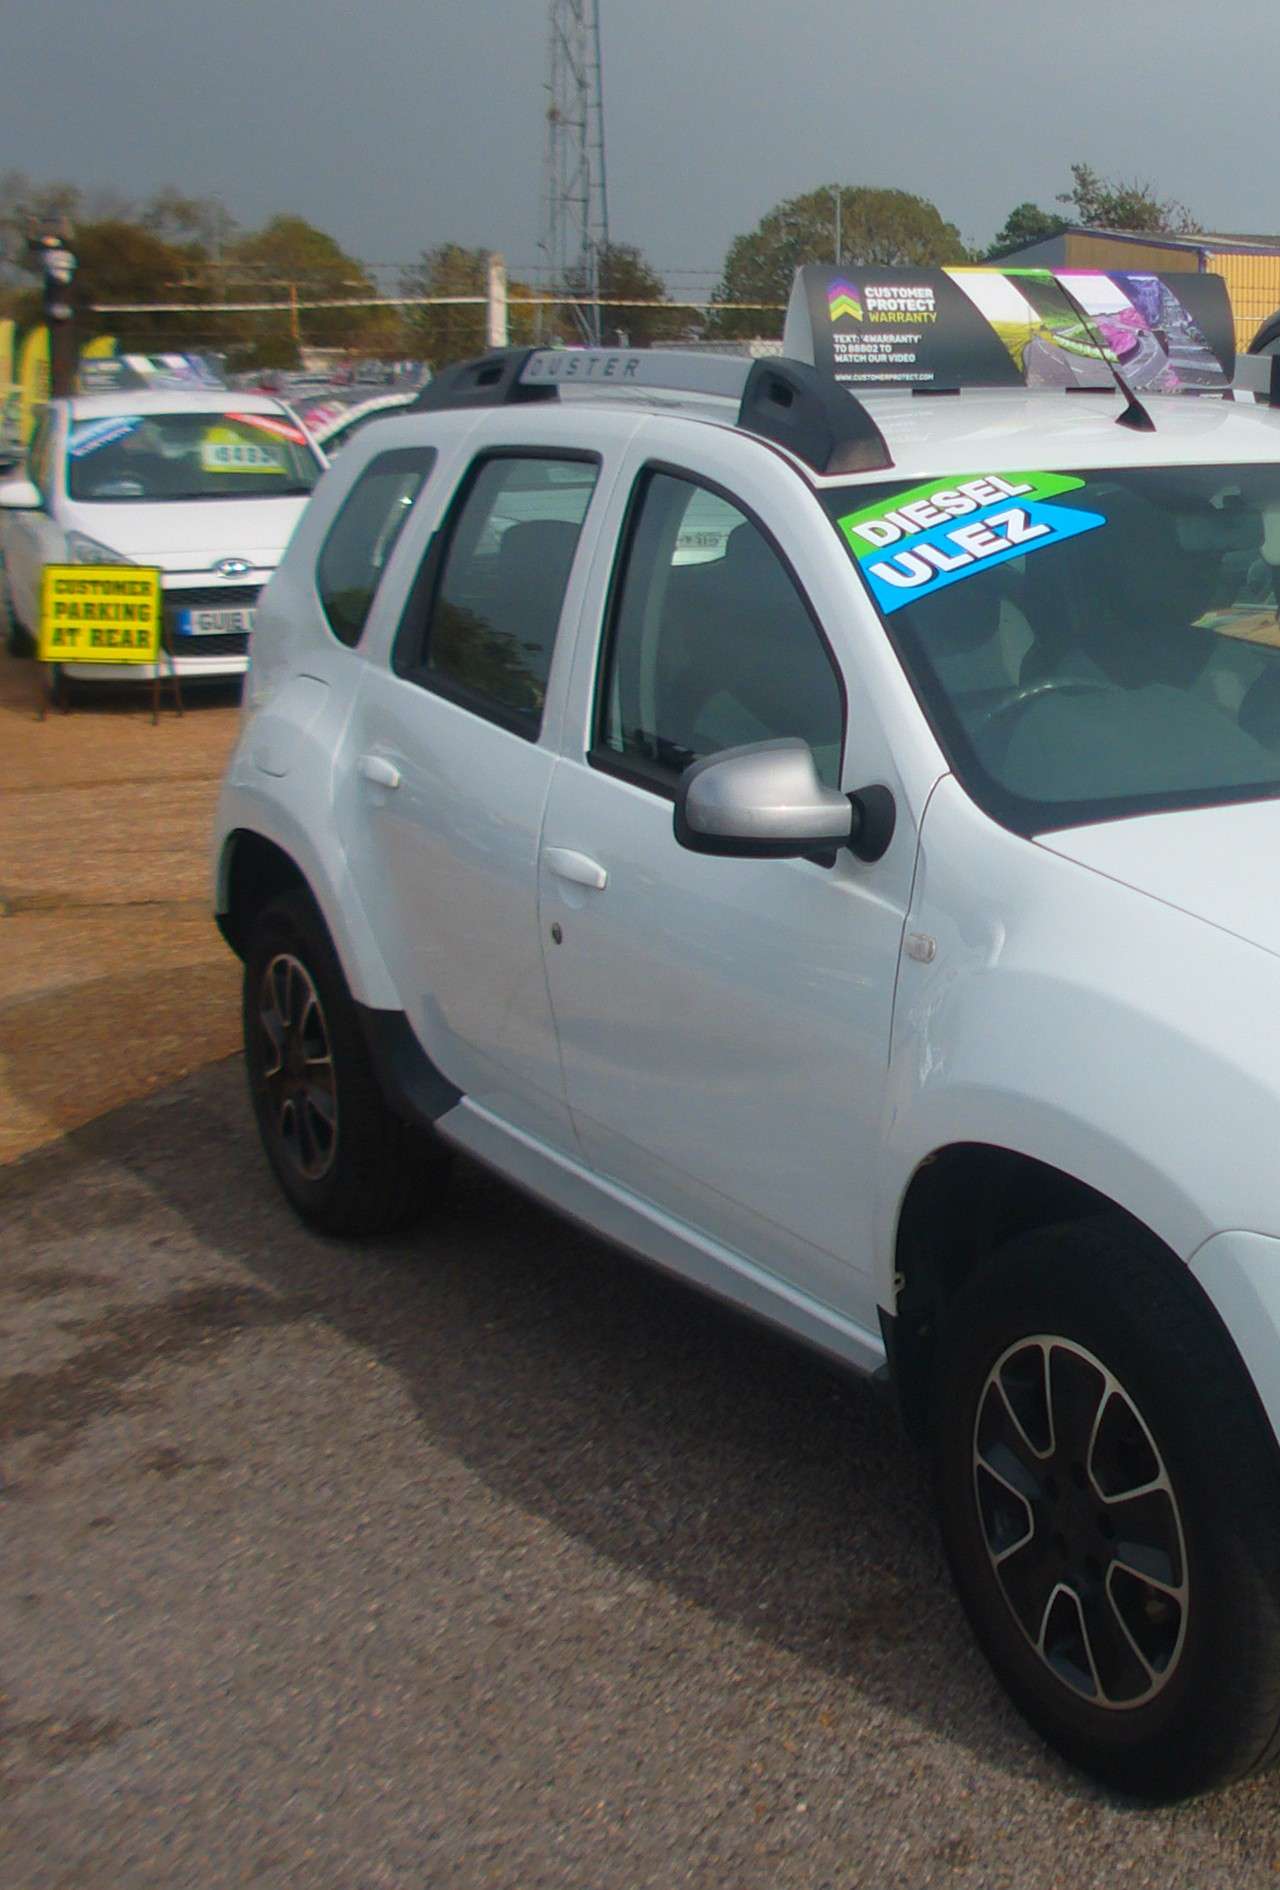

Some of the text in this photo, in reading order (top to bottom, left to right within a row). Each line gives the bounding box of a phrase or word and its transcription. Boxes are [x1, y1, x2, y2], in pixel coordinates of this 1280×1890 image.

[864, 287, 934, 298] CUSTOMER
[866, 299, 936, 311] PROTECT
[868, 312, 937, 322] WARRANTY
[834, 344, 847, 353] TO
[879, 344, 892, 353] TO
[834, 354, 916, 363] WATCH OUR VIDEO
[529, 358, 641, 377] DUSTER
[851, 475, 1034, 547] DIESEL
[868, 508, 1051, 588] ULEZ
[54, 580, 151, 595] CUSTOMER
[54, 602, 151, 622] PARKING
[52, 628, 150, 648] AT REAR
